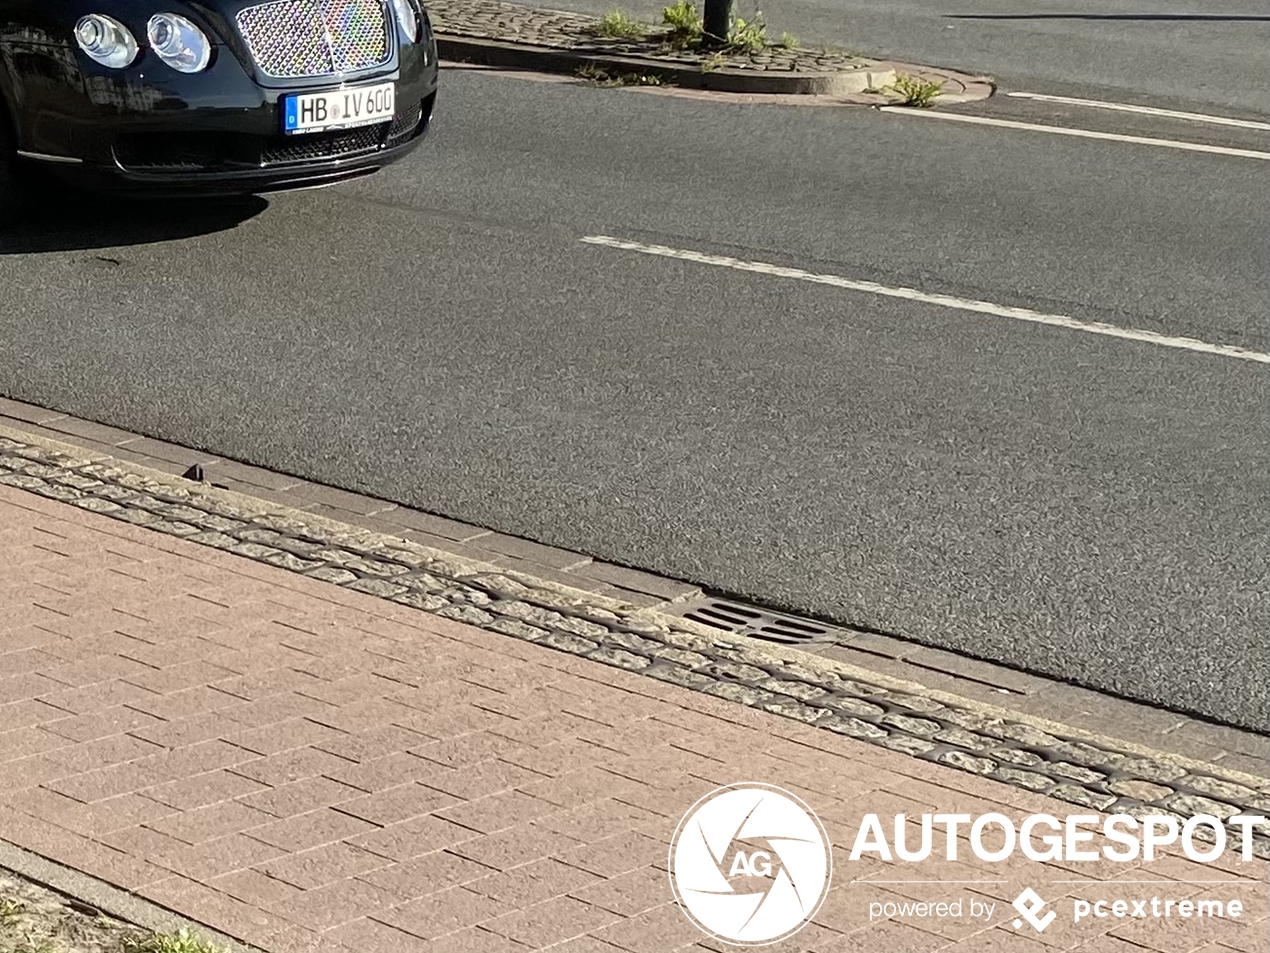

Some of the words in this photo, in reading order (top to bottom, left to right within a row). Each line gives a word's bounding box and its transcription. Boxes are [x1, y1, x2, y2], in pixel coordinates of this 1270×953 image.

[301, 97, 328, 124] HB
[342, 92, 363, 119] IV
[366, 87, 392, 115] 600
